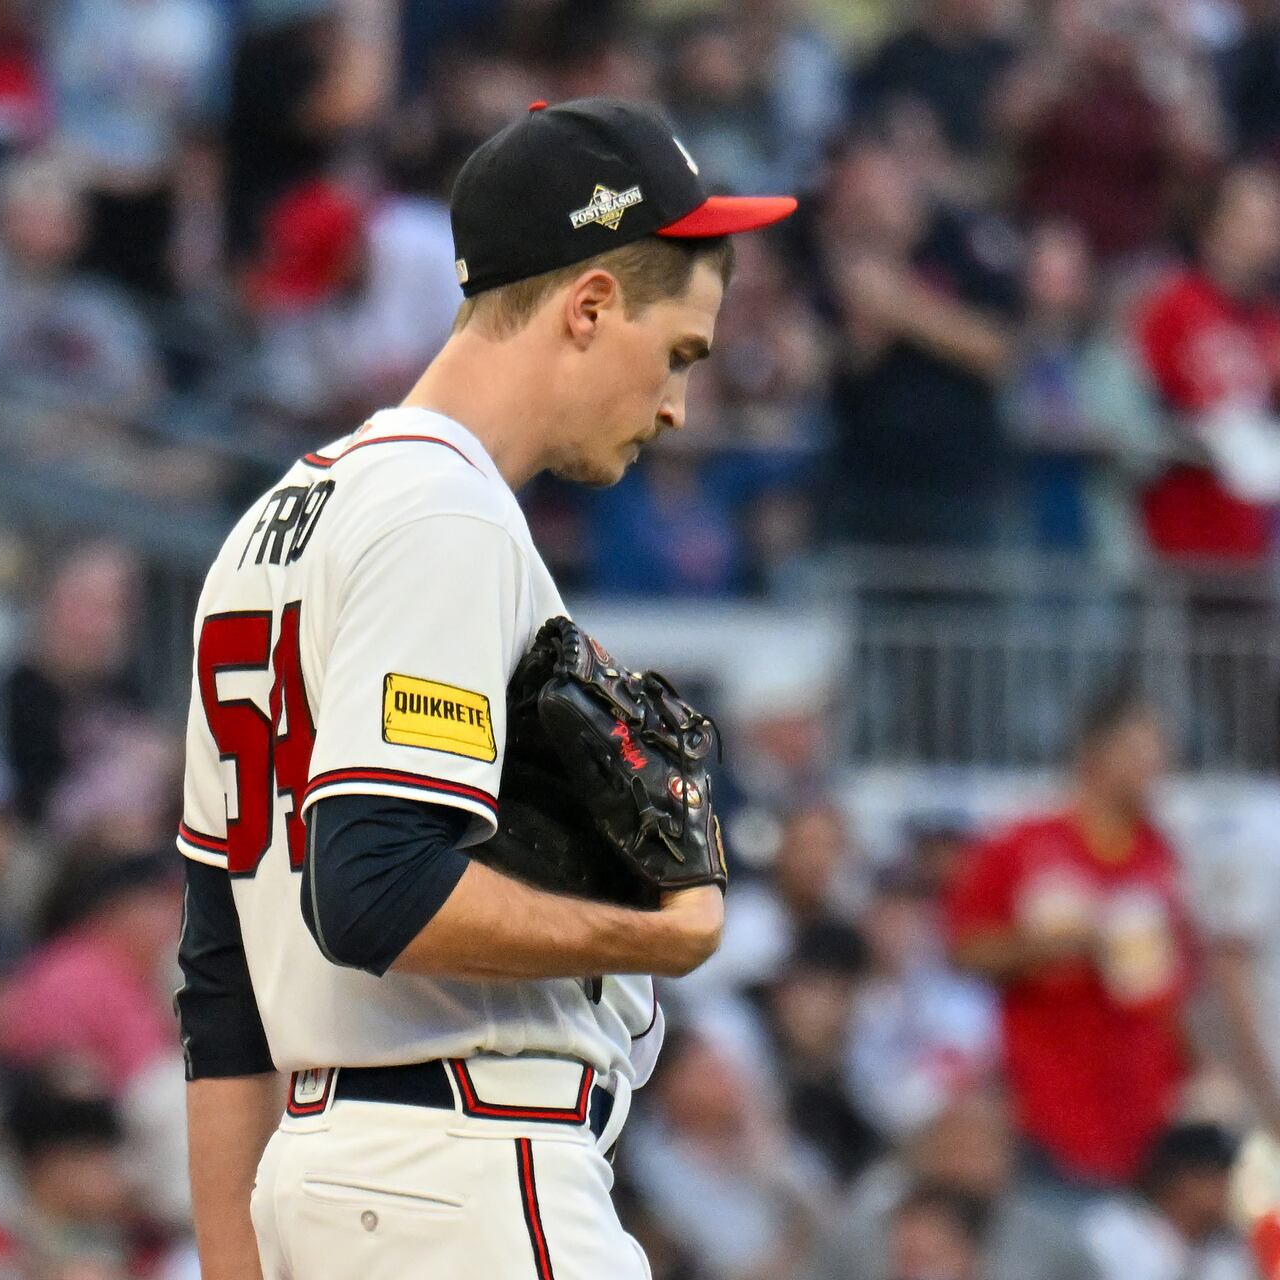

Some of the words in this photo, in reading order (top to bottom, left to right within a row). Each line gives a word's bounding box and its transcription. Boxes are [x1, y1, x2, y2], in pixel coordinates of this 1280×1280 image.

[569, 190, 642, 228] POSTSEASON
[394, 690, 486, 730] QUIKRETE
[197, 600, 317, 879] 54
